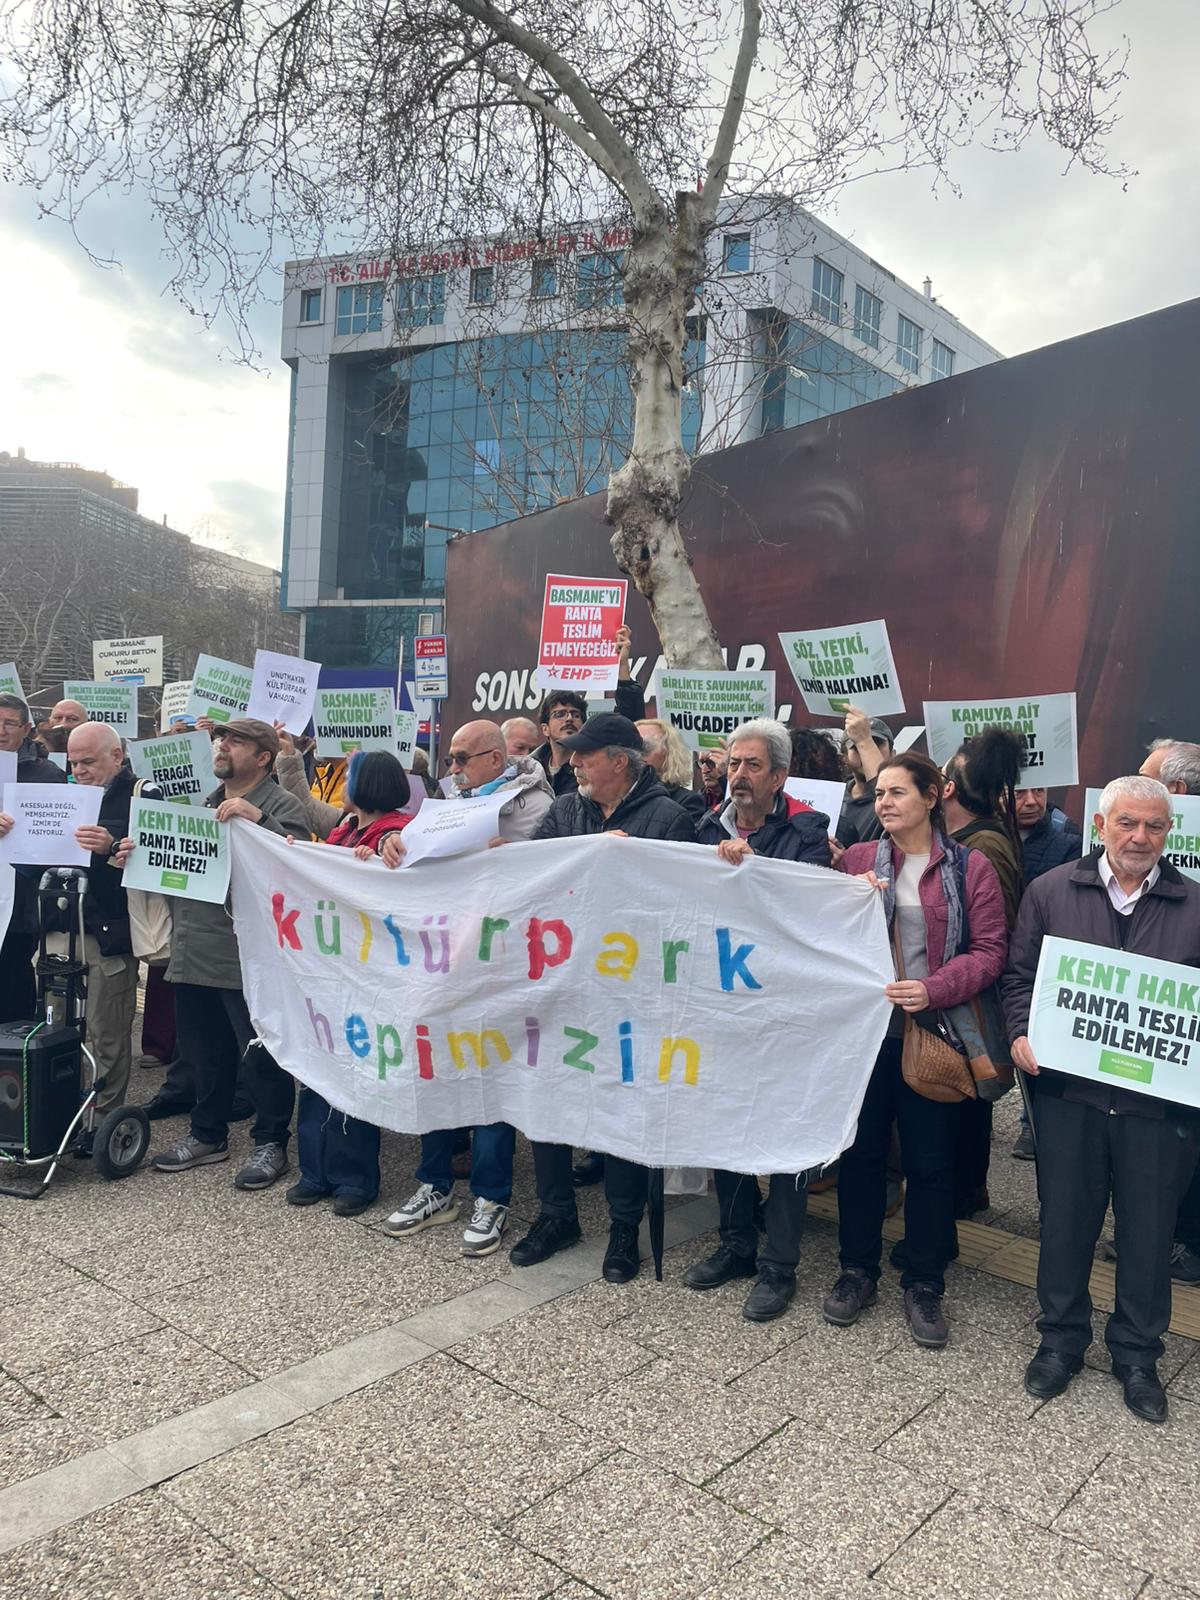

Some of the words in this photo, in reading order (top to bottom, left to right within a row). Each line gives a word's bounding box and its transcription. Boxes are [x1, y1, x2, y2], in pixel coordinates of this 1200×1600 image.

[550, 587, 620, 604] BASMANE'Yİ
[565, 607, 602, 621] RANTA
[562, 621, 603, 639] TESLİM
[793, 638, 819, 660] SÖZ,
[820, 632, 869, 657] YETKİ,
[561, 668, 592, 680] EHP
[809, 657, 855, 677] KARAR
[230, 674, 252, 689] NİYE
[662, 675, 703, 690] BİRLİKTE
[706, 679, 767, 692] SAVUNMAK,
[798, 674, 826, 694] İZMİR
[825, 673, 889, 695] HALKINA!
[321, 693, 377, 708] BASMANE
[674, 691, 708, 700] BİRLİKTE
[709, 692, 754, 702] KORUMAK,
[665, 699, 698, 710] BİRLİKTE
[699, 701, 746, 713] KAZANMAK
[747, 702, 765, 714] İÇİN
[952, 706, 1013, 722] KAMUYA
[1017, 702, 1040, 719] AİT
[327, 709, 373, 725] ÇUKURU
[317, 725, 392, 738] KAMUNUNDUR!
[143, 742, 178, 758] KAMUYA
[180, 739, 193, 752] AİT
[151, 752, 191, 769] OLANDAN
[152, 764, 194, 783] FERAGAT
[159, 779, 201, 797] DİLEMEZ!
[138, 809, 173, 833] KENT
[177, 815, 220, 840] HAKKI
[139, 832, 176, 851] RANTA
[179, 838, 218, 858] TESLİM
[148, 851, 207, 874] EDİLEMEZ!
[271, 892, 763, 994] kültürpark
[1056, 954, 1131, 995] KENT
[1136, 972, 1200, 1014] HAK
[1056, 987, 1130, 1024] RANTA
[1138, 1006, 1200, 1043] TESLİ
[305, 996, 701, 1089] hepimizin
[1071, 1016, 1191, 1066] EDİLEMEZ!
